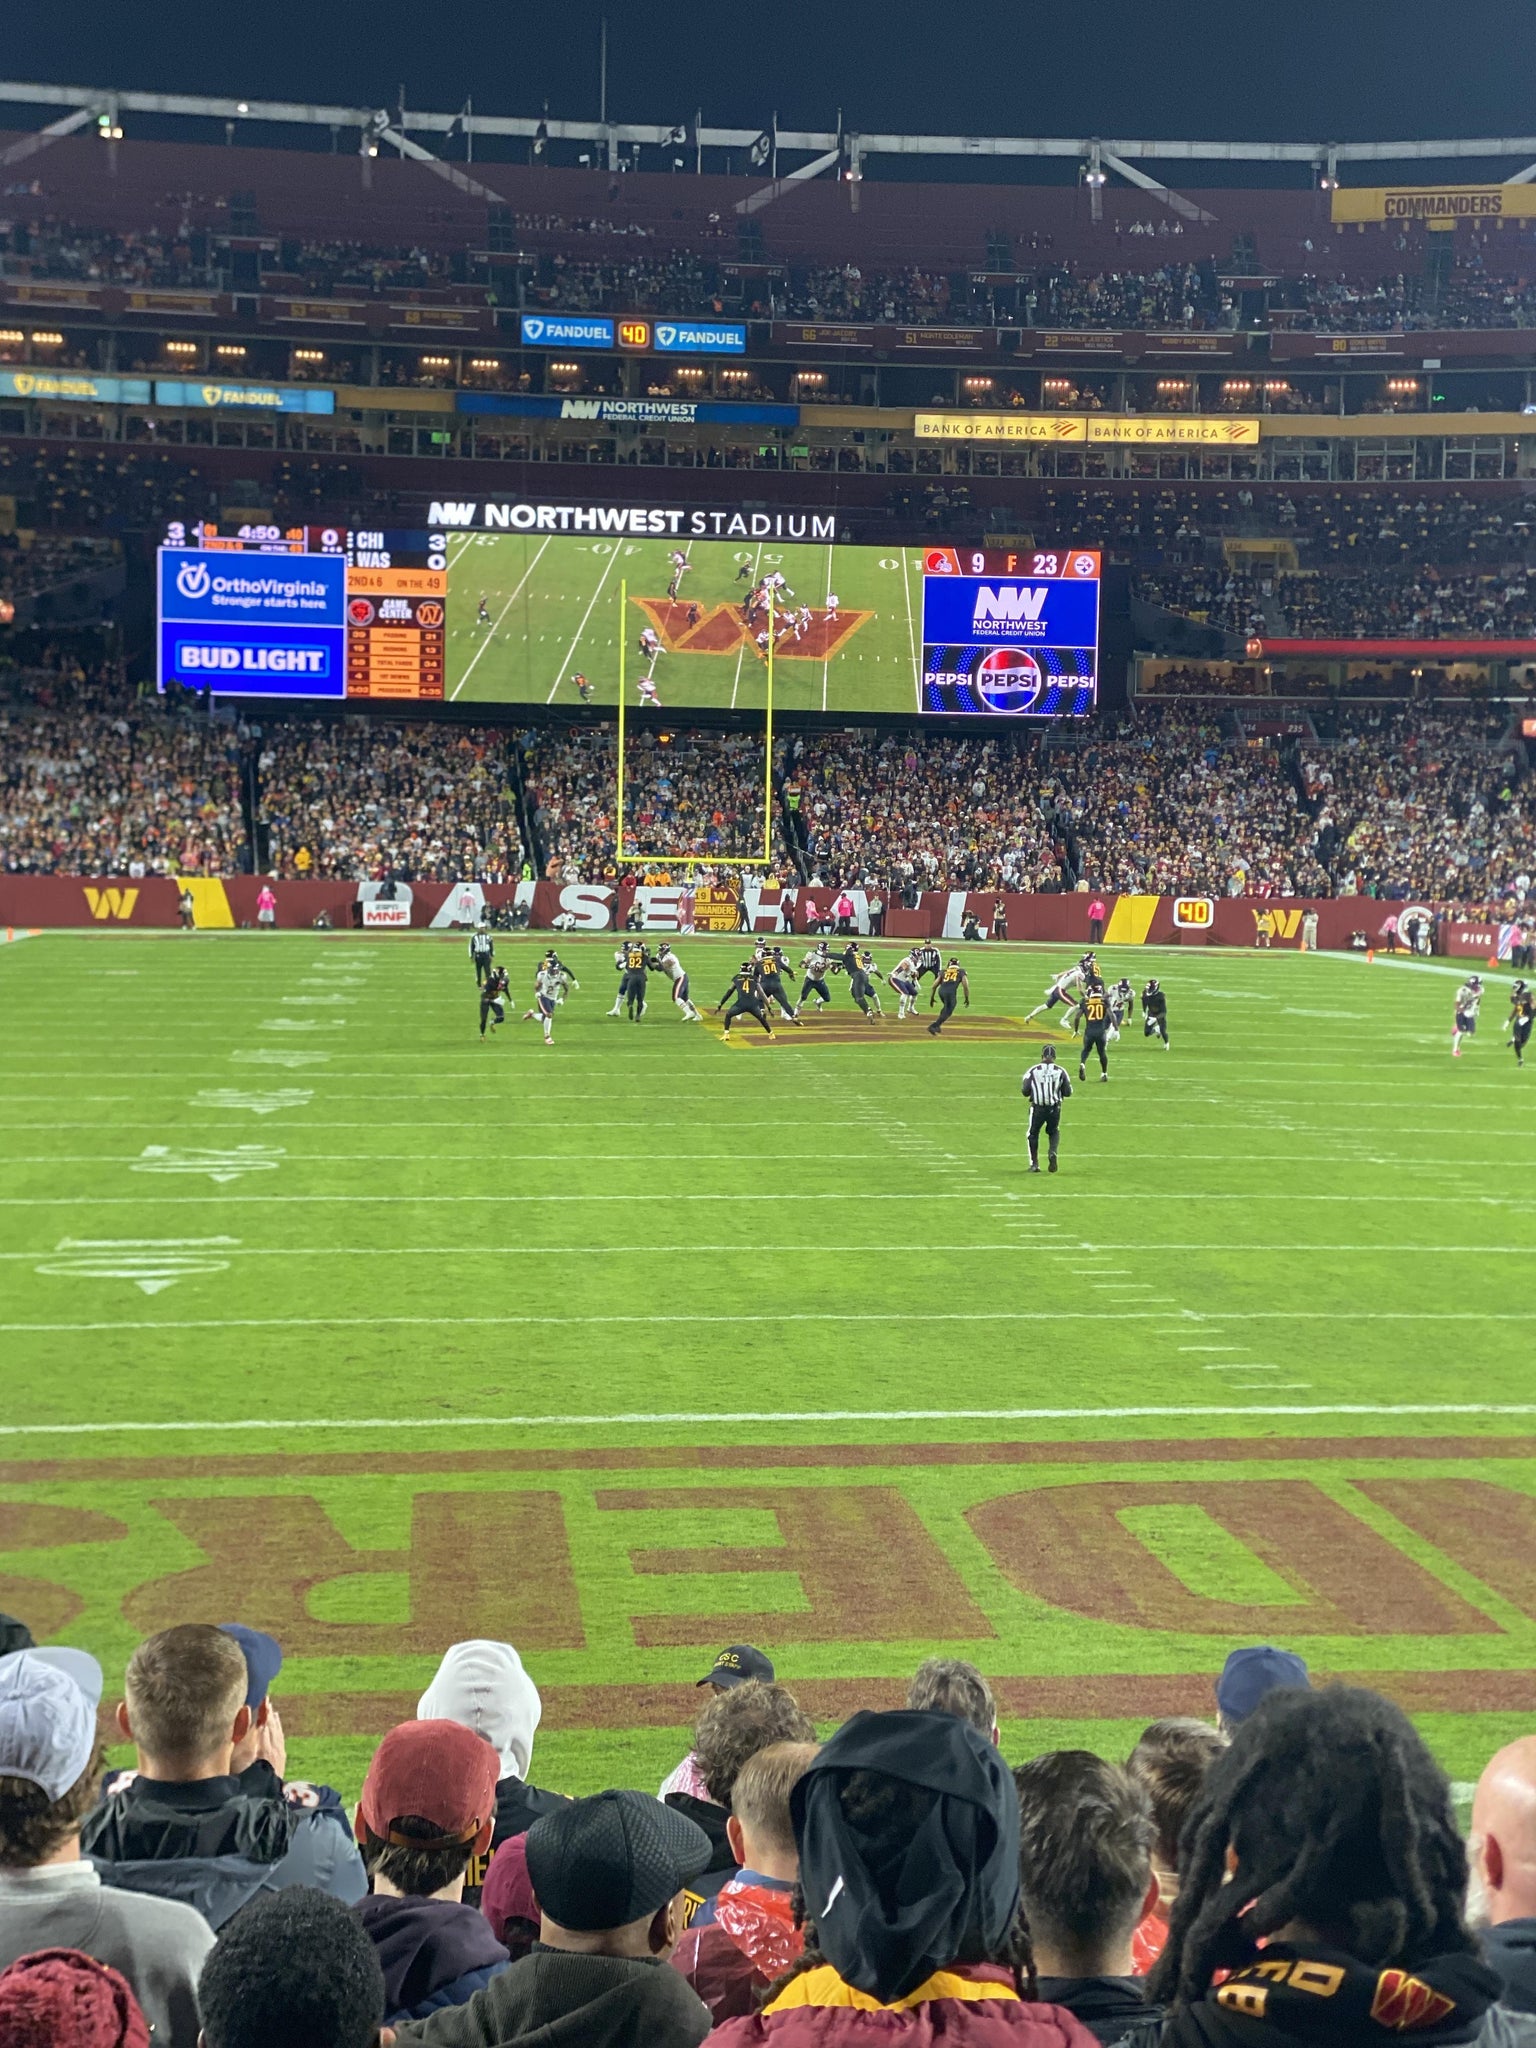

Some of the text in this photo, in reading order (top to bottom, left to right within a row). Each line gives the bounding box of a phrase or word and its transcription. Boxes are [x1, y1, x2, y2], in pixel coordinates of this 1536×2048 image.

[1385, 196, 1503, 216] COMMANDERS
[546, 325, 611, 339] FANDUEL
[622, 326, 646, 344] 40
[679, 331, 743, 345] FANDUEL
[905, 332, 917, 344] 51
[1044, 335, 1059, 347] 22
[1332, 339, 1347, 351] 80
[223, 393, 283, 406] FANDUEL
[602, 402, 698, 416] NORTHWEST
[602, 413, 695, 423] FEDERAL CREDIT UNION
[923, 424, 1047, 436] BANK OF AMERICA
[1094, 427, 1218, 439] BANK OF AMERICA
[427, 502, 476, 526] NW
[485, 504, 836, 538] NORTHWEST STADIUM
[167, 521, 186, 540] 3
[237, 524, 281, 540] 4:50
[320, 529, 339, 546] 0
[357, 531, 446, 551] CHI 3
[357, 551, 446, 570] WAS 0
[972, 553, 1057, 575] 9 F 23
[212, 576, 327, 597] OrthoVirginia
[348, 576, 368, 587] 2ND
[376, 577, 383, 587] 6
[397, 578, 441, 589] ON THE 49
[212, 596, 259, 608] Stronger
[263, 598, 297, 608] starts
[382, 599, 409, 608] GAME
[973, 586, 1049, 620] NW
[379, 607, 413, 619] CENTER
[973, 620, 1048, 631] NORTHWEST
[181, 647, 324, 672] BUD LIGHT
[924, 673, 973, 686] PEPSI
[981, 674, 1037, 688] PEPSI
[1046, 676, 1095, 688] PEPSI
[366, 911, 407, 921] MNF
[1180, 902, 1207, 922] 40
[714, 922, 726, 930] 32
[1461, 933, 1492, 945] FIVE
[628, 956, 642, 969] 92
[763, 963, 777, 975] 94
[743, 978, 750, 994] 4
[1086, 1004, 1104, 1021] 20
